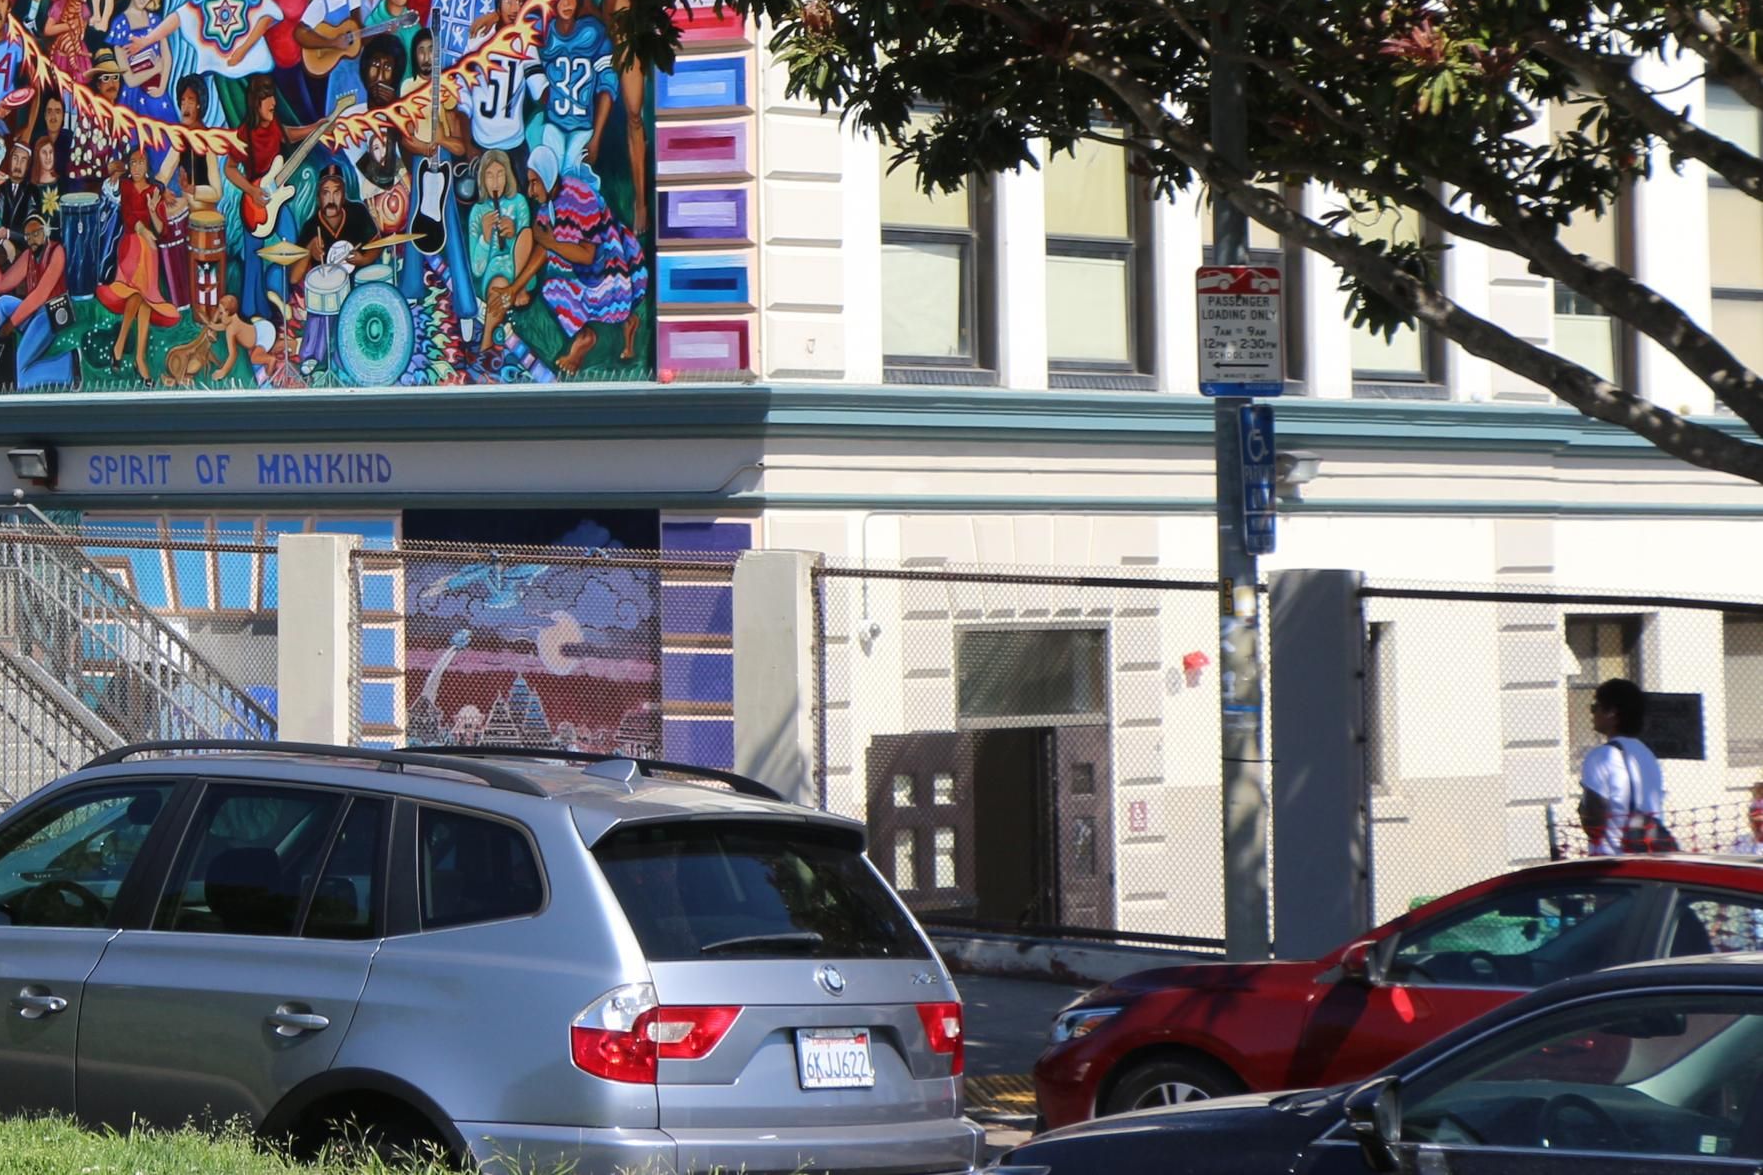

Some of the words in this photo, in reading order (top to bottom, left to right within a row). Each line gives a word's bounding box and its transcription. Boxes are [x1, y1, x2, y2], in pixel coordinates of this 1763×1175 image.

[555, 56, 591, 115] 32
[1208, 296, 1270, 307] PASSENGER
[1202, 309, 1246, 320] LOADING
[1250, 310, 1277, 320] ONLY
[1213, 326, 1232, 336] 7AM
[1247, 326, 1267, 336] 9AM
[1240, 338, 1277, 349] 2:30PM
[1208, 351, 1244, 359] SCHOOL
[1249, 351, 1274, 359] DAYS
[88, 454, 171, 485] SPIRIT
[195, 454, 230, 485] OF
[257, 453, 392, 484] MANKIND
[806, 1050, 868, 1078] 6KJJ622
